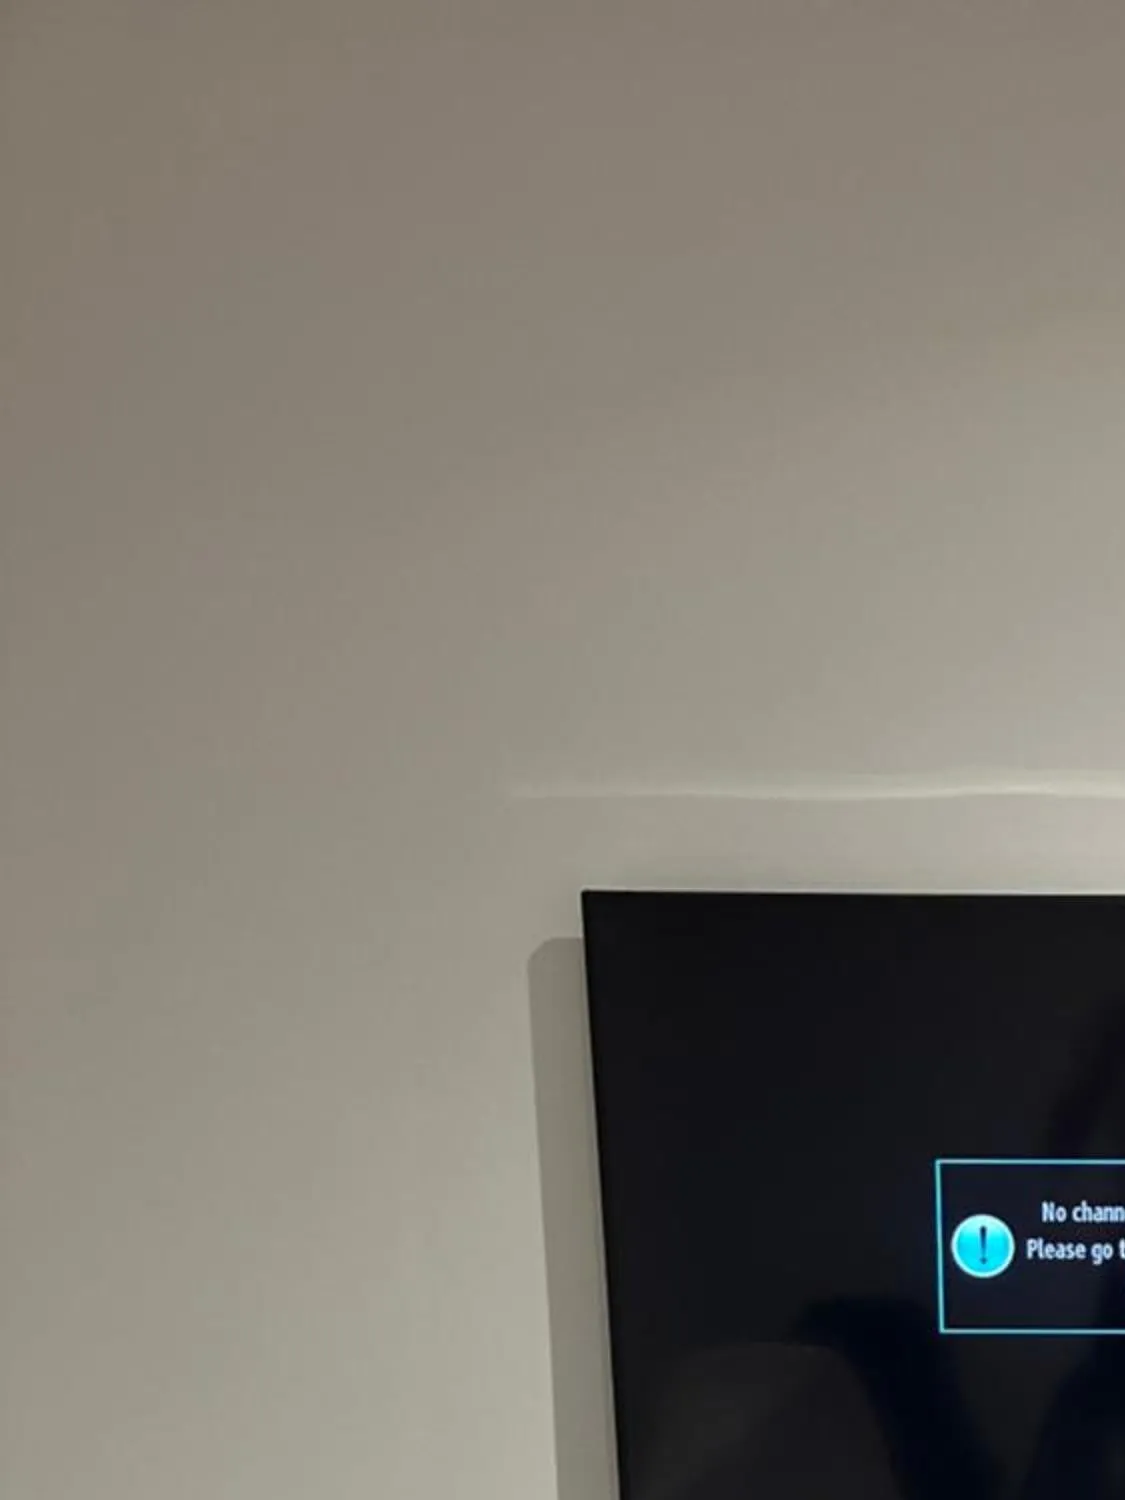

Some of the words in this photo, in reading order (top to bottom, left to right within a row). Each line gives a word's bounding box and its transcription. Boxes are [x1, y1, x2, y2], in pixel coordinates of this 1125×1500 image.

[1042, 1201, 1066, 1222] No
[1027, 1239, 1086, 1260] Please
[1091, 1243, 1113, 1265] go
